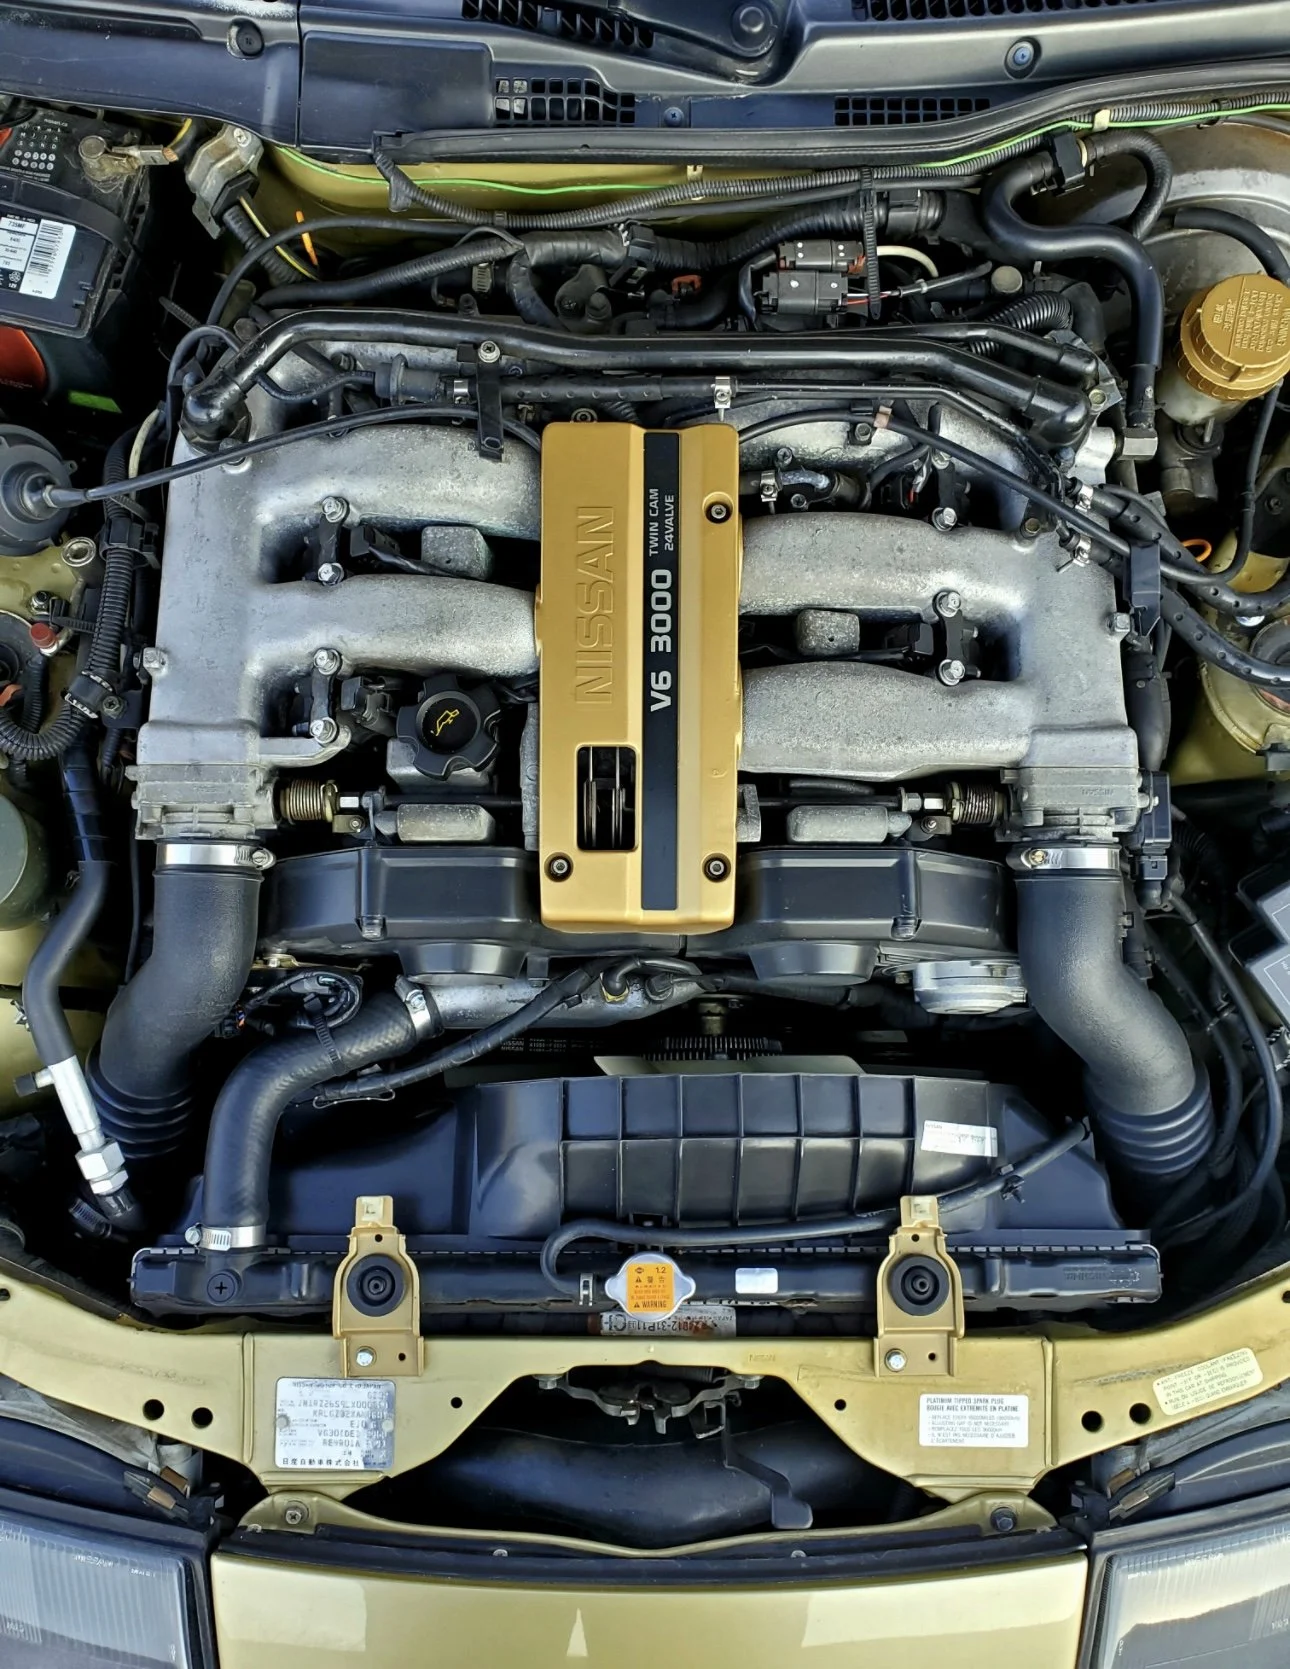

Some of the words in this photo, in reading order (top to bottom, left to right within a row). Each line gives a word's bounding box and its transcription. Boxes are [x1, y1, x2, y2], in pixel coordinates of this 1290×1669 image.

[649, 488, 659, 516] CAM
[664, 495, 674, 551] 24VALVE
[649, 521, 659, 556] TWIN
[576, 506, 614, 704] NISSAN
[651, 569, 672, 652] 3000
[651, 670, 672, 712] V6
[282, 1458, 359, 1466] 日産自動車株式会社
